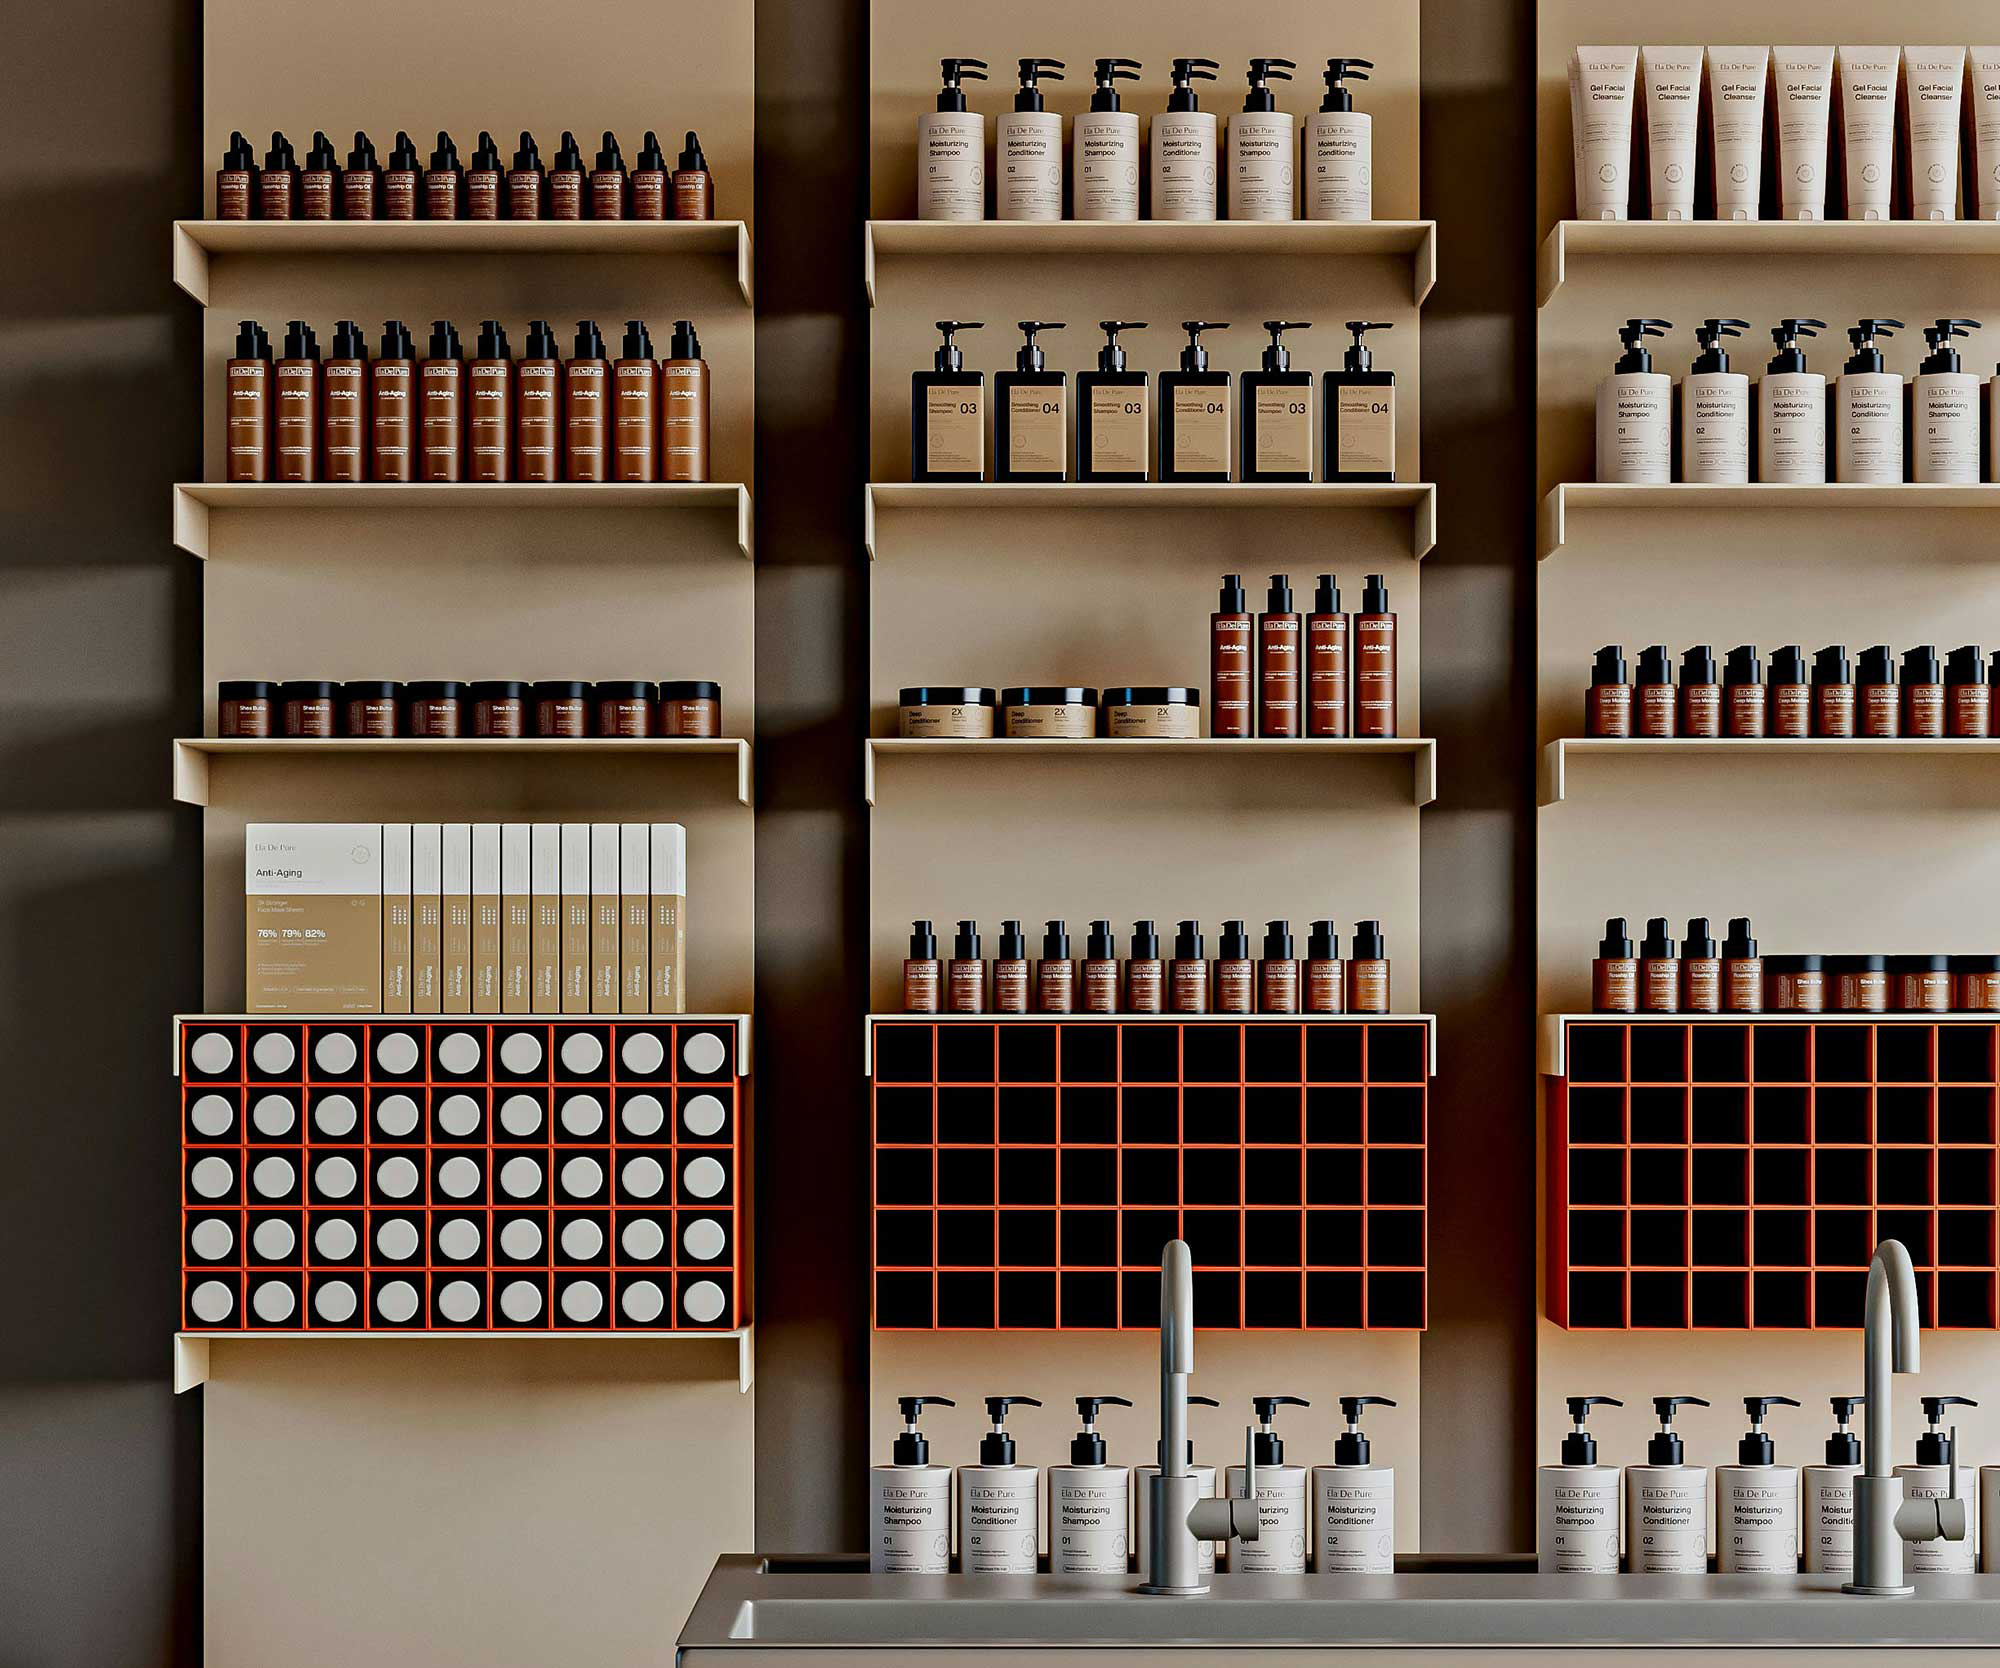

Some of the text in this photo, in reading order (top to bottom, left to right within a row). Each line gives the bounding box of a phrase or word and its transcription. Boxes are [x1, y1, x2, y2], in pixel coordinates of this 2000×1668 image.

[1590, 84, 1626, 92] Gel Facial
[1656, 84, 1691, 92] Gel Facial
[1721, 84, 1756, 92] Gel Facial
[1787, 84, 1822, 92] Gel Facial
[1852, 84, 1888, 92] Gel Facial
[1918, 84, 1954, 92] Gel Facial
[1984, 84, 1997, 92] Gel
[1592, 93, 1624, 101] Cleanser
[1658, 93, 1690, 101] Cleanser
[1723, 93, 1755, 101] Cleanser
[1789, 93, 1821, 101] Cleanser
[1855, 93, 1887, 101] Cleanser
[1920, 93, 1952, 101] Cleanser
[929, 140, 968, 149] Moisturizing
[1007, 140, 1047, 149] Moisturizing
[1084, 140, 1124, 149] Moisturizing
[1162, 140, 1202, 149] Moisturizing
[1239, 140, 1279, 149] Moisturizing
[1317, 140, 1357, 149] Moisturizing
[929, 149, 961, 158] Shampoo
[1007, 149, 1045, 157] Conditioner
[1084, 149, 1116, 158] Shampoo
[1162, 149, 1200, 157] Conditioner
[1239, 149, 1271, 158] Shampoo
[1317, 149, 1355, 157] Conditioner
[960, 402, 977, 414] 03
[1042, 402, 1060, 414] 04
[1124, 402, 1141, 414] 03
[1206, 402, 1224, 414] 04
[1289, 402, 1306, 414] 03
[1371, 402, 1389, 414] 04
[1618, 402, 1657, 410] Moisturizing
[1696, 402, 1735, 410] Moisturizing
[1773, 402, 1812, 410] Moisturizing
[1851, 402, 1890, 410] Moisturizing
[1928, 402, 1967, 410] Moisturizing
[1618, 411, 1650, 419] Shampoo
[1773, 411, 1805, 419] Shampoo
[1928, 411, 1960, 419] Shampoo
[1618, 427, 1626, 435] 01
[1696, 427, 1706, 435] 02
[1773, 427, 1781, 435] 01
[1851, 427, 1860, 435] 02
[1928, 427, 1936, 435] 01
[952, 708, 963, 716] 2X
[1054, 708, 1065, 716] 2X
[1157, 708, 1168, 716] 2X
[256, 869, 303, 878] Anti-Aging
[257, 929, 326, 938] 76% 79% 82%
[883, 1489, 928, 1498] Ela De Pure
[970, 1489, 1016, 1498] Ela De Pure
[1062, 1489, 1107, 1498] Ela De Pure
[1327, 1489, 1372, 1498] Ela De Pure
[1555, 1489, 1600, 1498] Ela De Pure
[1642, 1489, 1687, 1498] Ela De Pure
[1733, 1489, 1779, 1498] Ela De Pure
[1820, 1489, 1847, 1498] Ela De
[1912, 1489, 1923, 1498] Ela
[1925, 1489, 1938, 1498] De
[884, 1505, 932, 1515] Moisturizing
[971, 1505, 1019, 1515] Moisturizing
[1062, 1505, 1110, 1515] Moisturizing
[1328, 1505, 1376, 1515] Moisturizing
[1555, 1505, 1603, 1515] Moisturizing
[1643, 1505, 1691, 1515] Moisturizing
[1734, 1505, 1782, 1515] Moisturizing
[884, 1516, 922, 1526] Shampoo
[971, 1516, 1018, 1525] Conditioner
[1062, 1516, 1101, 1526] Shampoo
[1328, 1516, 1374, 1525] Conditioner
[1555, 1516, 1594, 1526] Shampoo
[1643, 1516, 1689, 1525] Conditioner
[1734, 1516, 1773, 1526] Shampoo
[883, 1536, 893, 1545] 01
[971, 1536, 982, 1545] 02
[1062, 1536, 1071, 1545] 01
[1327, 1536, 1338, 1545] 02
[1555, 1536, 1564, 1545] 01
[1643, 1536, 1654, 1545] 02
[1734, 1536, 1743, 1545] 01
[1821, 1536, 1832, 1545] 02
